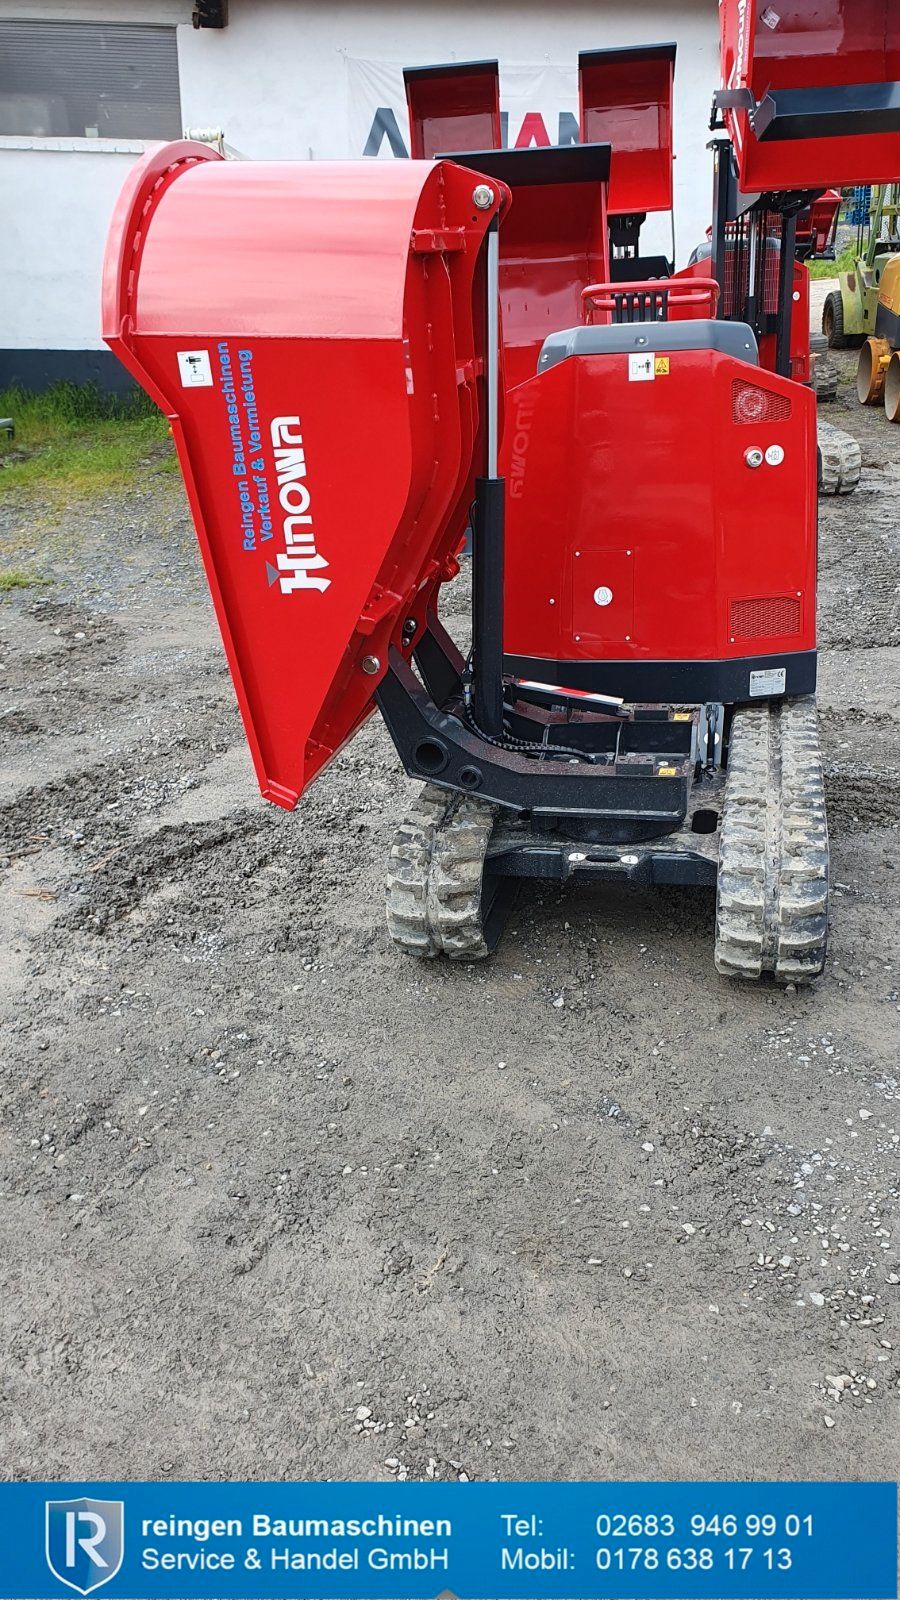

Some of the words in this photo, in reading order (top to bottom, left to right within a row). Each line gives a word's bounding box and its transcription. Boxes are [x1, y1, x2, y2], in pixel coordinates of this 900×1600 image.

[217, 341, 247, 476] Baumaschinen
[238, 349, 260, 453] Vermietung
[251, 457, 265, 471] &
[237, 480, 256, 551] Reingen
[256, 475, 273, 542] Verkauf
